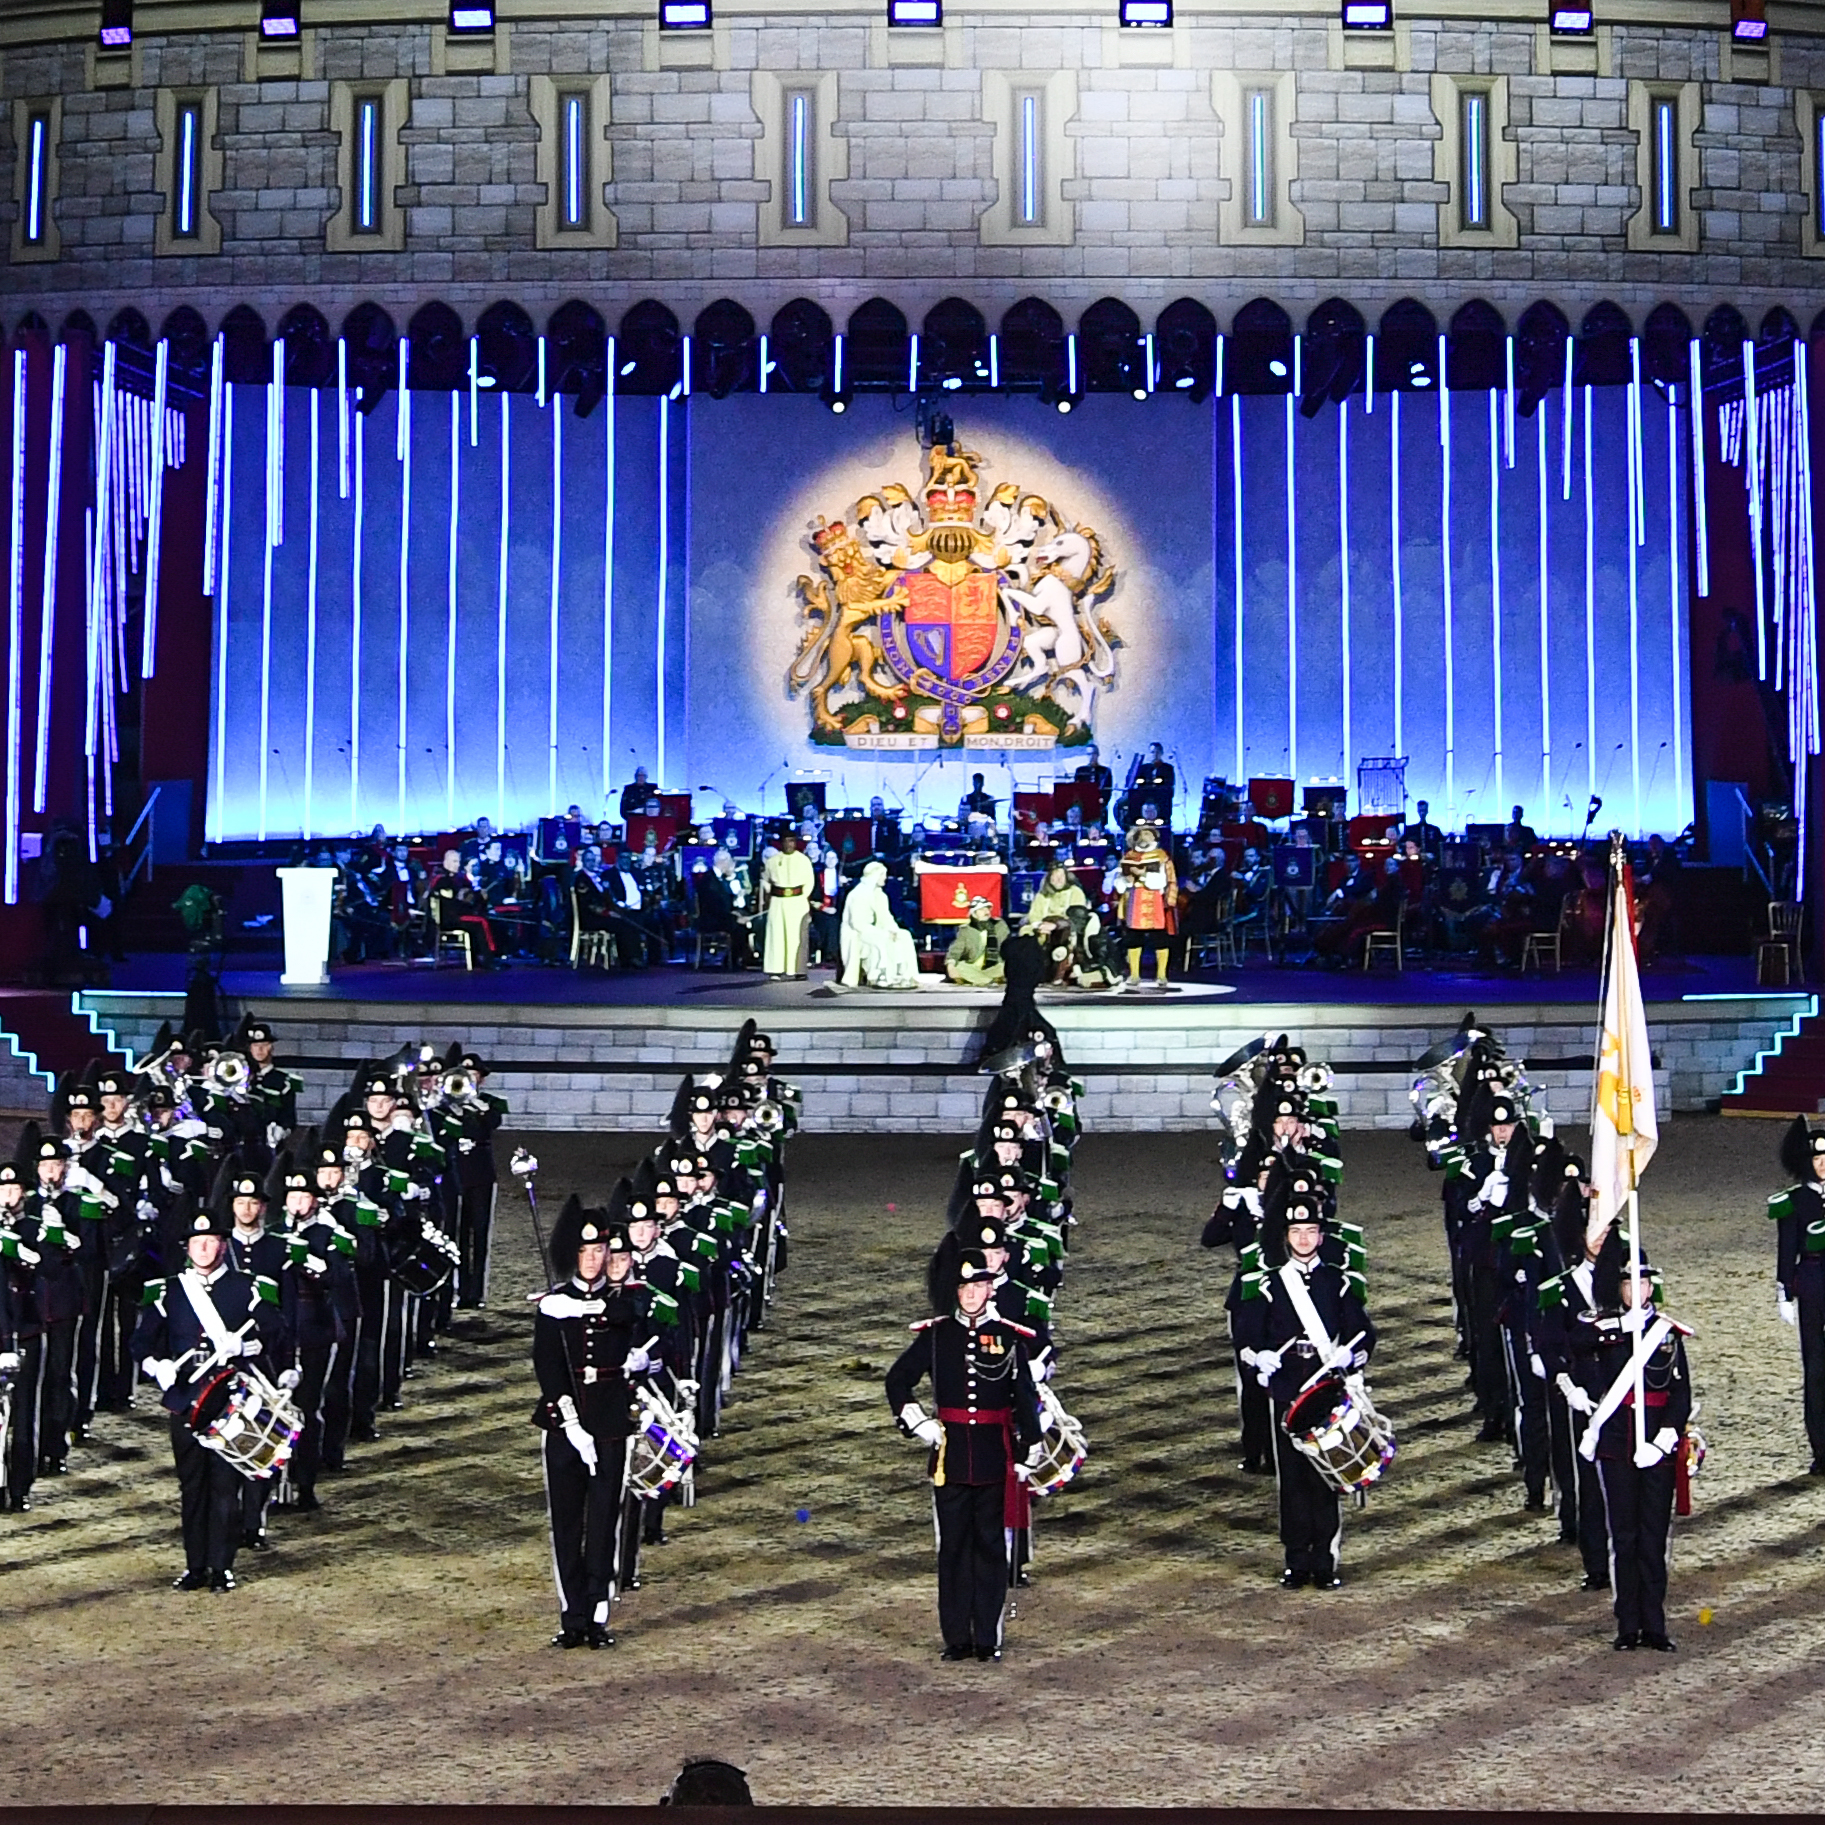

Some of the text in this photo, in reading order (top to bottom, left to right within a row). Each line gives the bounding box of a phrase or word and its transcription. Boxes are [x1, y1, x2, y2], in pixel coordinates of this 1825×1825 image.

[857, 737, 1052, 748] DIEU ET MON DROIT
